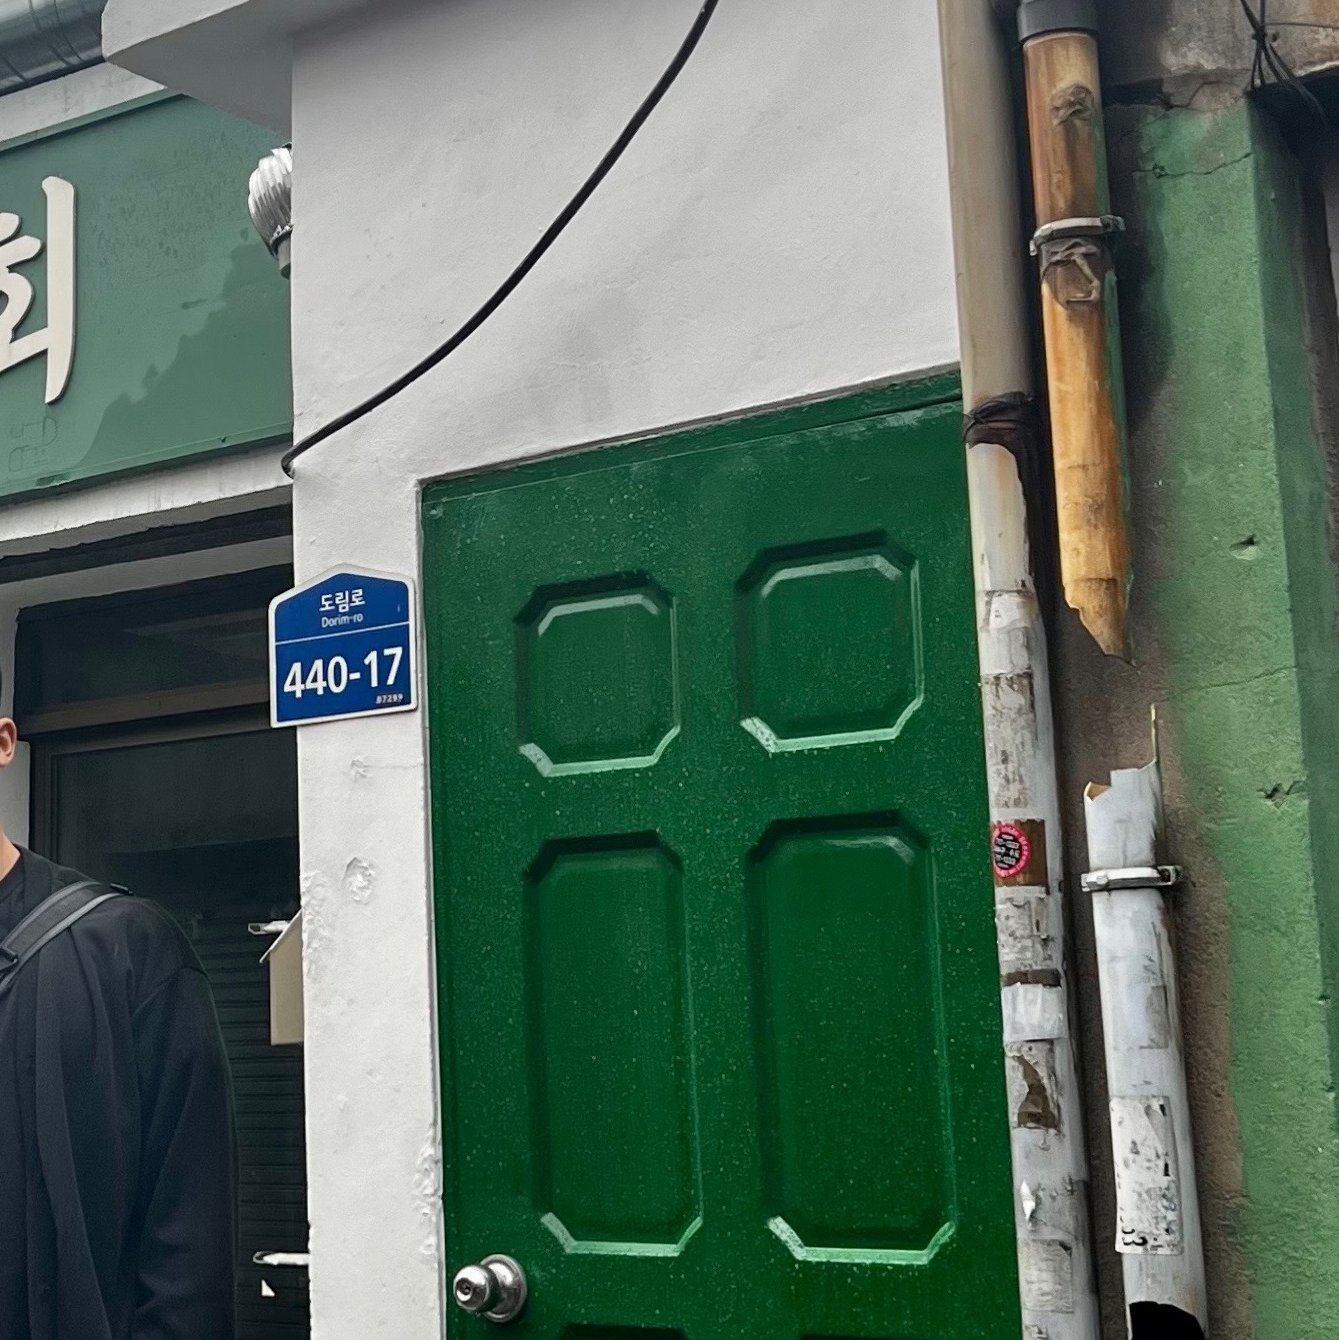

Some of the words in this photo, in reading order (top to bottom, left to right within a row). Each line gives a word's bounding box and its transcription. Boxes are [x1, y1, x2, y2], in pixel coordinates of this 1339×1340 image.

[319, 588, 366, 613] 도림로
[322, 613, 363, 628] Dorim-ro
[284, 647, 403, 698] 440-17
